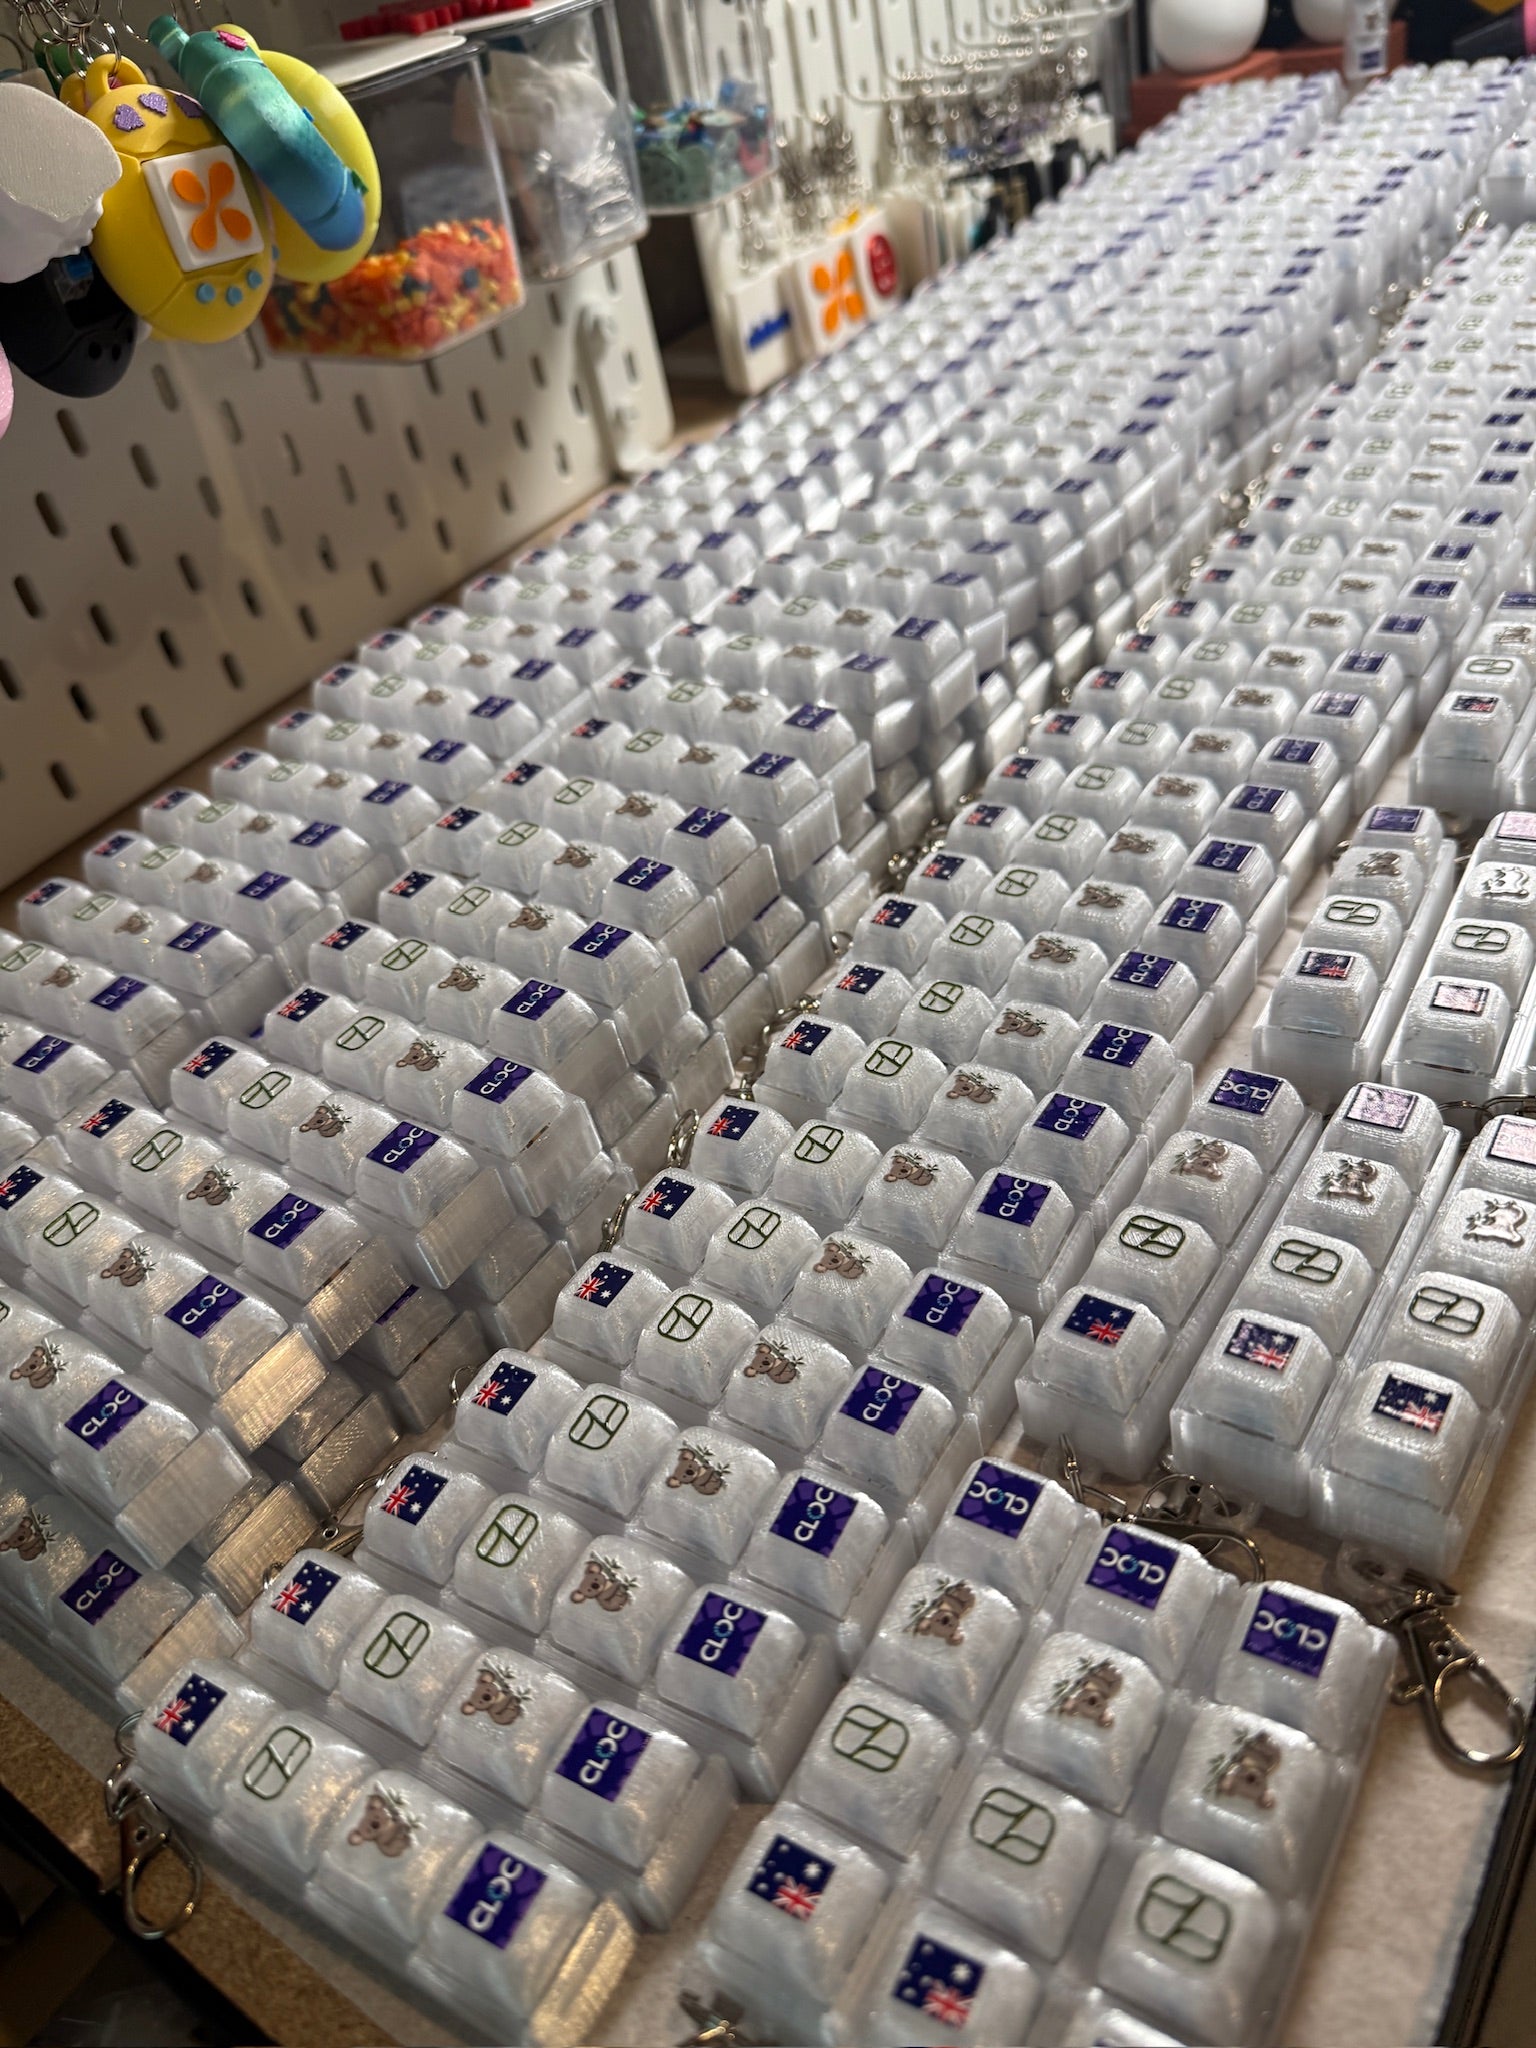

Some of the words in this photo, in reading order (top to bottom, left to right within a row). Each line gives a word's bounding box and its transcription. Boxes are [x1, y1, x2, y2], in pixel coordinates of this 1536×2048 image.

[628, 860, 660, 885] CLOC
[1177, 900, 1204, 927] CLOC
[584, 926, 617, 952] CLOC
[1129, 955, 1158, 982] CLOC
[517, 985, 551, 1013] CLOC
[25, 1040, 61, 1067] CLOC
[1103, 1029, 1133, 1059] CLOC
[481, 1063, 517, 1094] CLOC
[1220, 1079, 1270, 1100] CLOC
[1054, 1100, 1085, 1130] CLOC
[384, 1128, 424, 1163] CLOC
[999, 1179, 1029, 1216] CLOC
[265, 1200, 308, 1238] CLOC
[182, 1284, 228, 1324] CLOC
[926, 1282, 961, 1323] CLOC
[81, 1390, 130, 1436] CLOC
[863, 1376, 900, 1421] CLOC
[795, 1487, 834, 1541] CLOC
[969, 1481, 1028, 1514] CLOC
[1100, 1547, 1165, 1584] CLOC
[76, 1562, 124, 1610] CLOC
[700, 1603, 742, 1661] CLOC
[1255, 1610, 1326, 1650] CLOC
[580, 1719, 627, 1783] CLOC
[469, 1858, 522, 1931] CLOC
